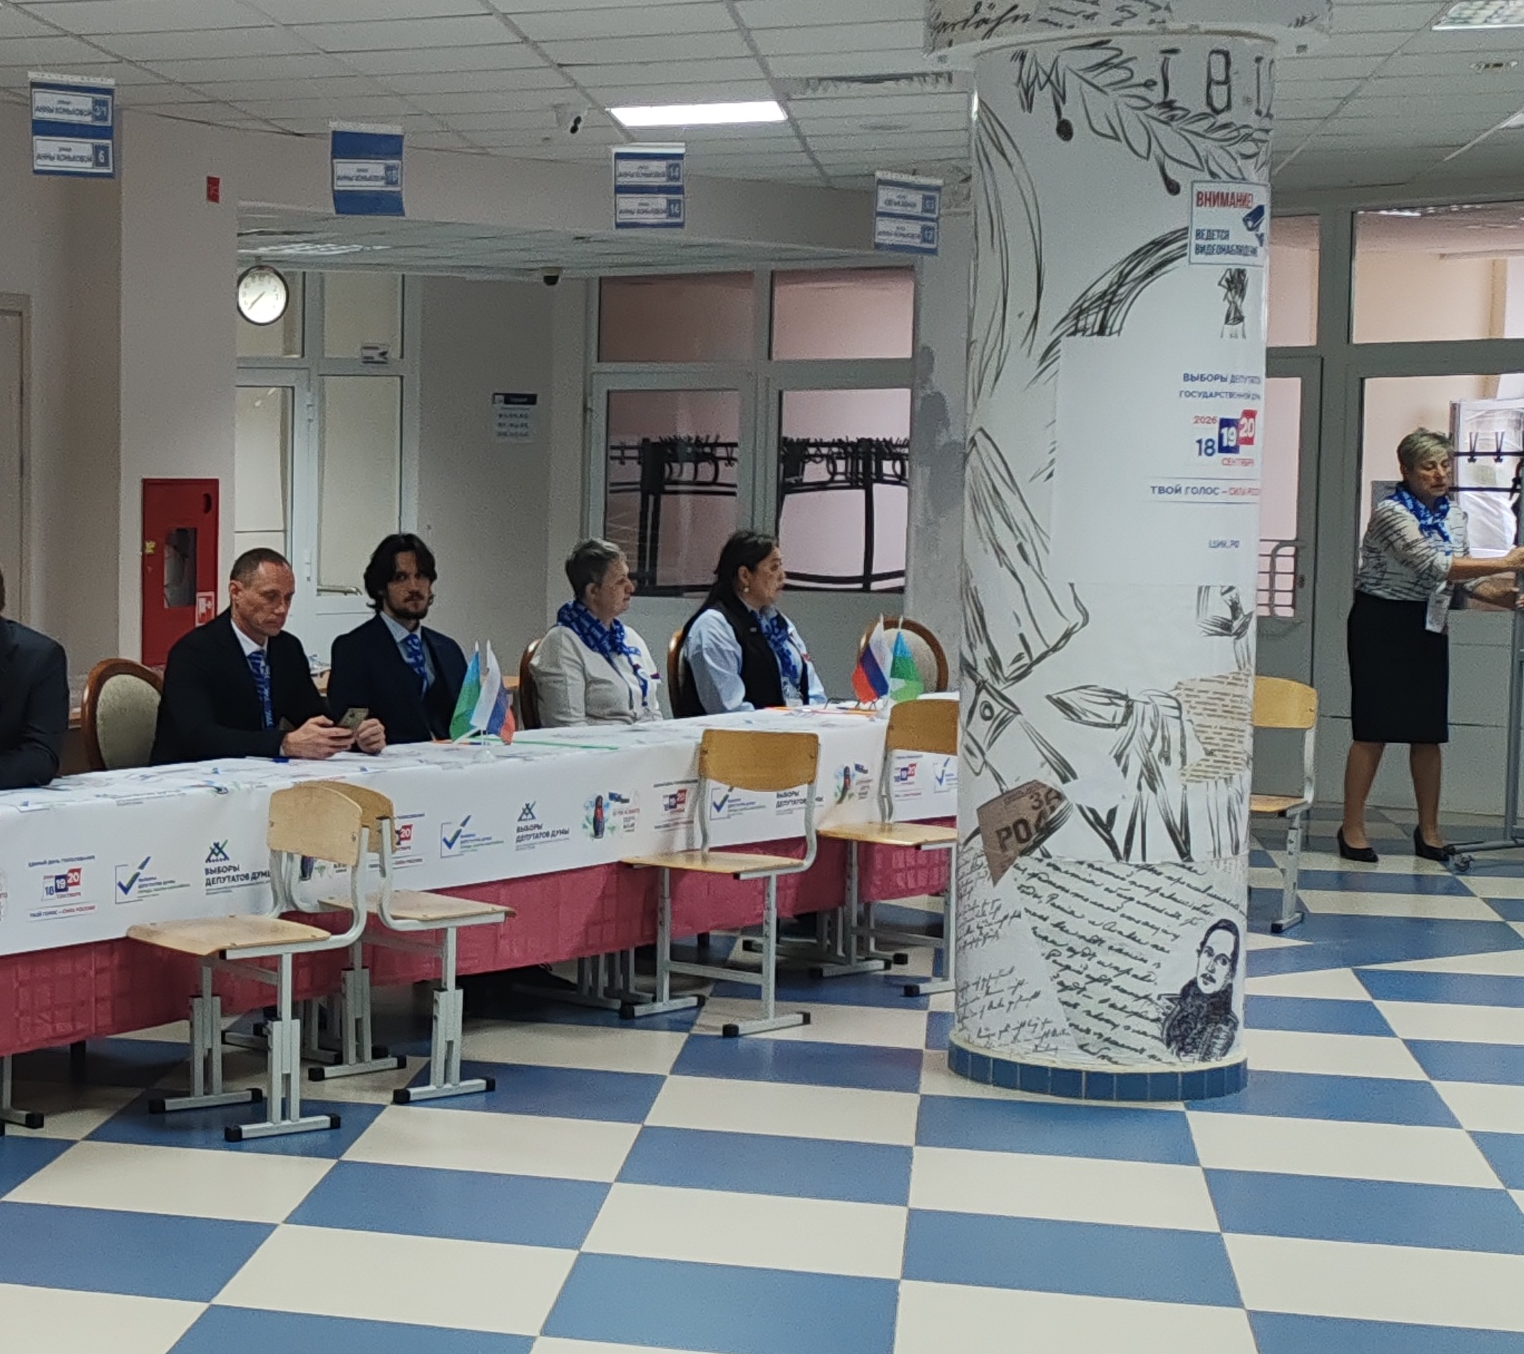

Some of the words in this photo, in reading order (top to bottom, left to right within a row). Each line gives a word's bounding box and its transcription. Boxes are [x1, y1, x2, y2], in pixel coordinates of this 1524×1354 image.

[98, 150, 106, 163] 6
[1196, 190, 1253, 209] ВНИМАНИЕ
[1182, 372, 1228, 383] ВЫБОРЫ
[1193, 415, 1218, 425] 2026
[1239, 416, 1255, 438] 20
[1220, 426, 1237, 447] 19
[1195, 438, 1217, 457] 18
[1150, 484, 1182, 495] ТВОЙ
[1184, 486, 1220, 496] ГОЛОС
[400, 828, 412, 838] 20
[516, 823, 543, 834] ВЫБОРЫ
[515, 830, 550, 844] ДЕПУТАТОВ
[205, 864, 240, 876] ВЫБОРЫ
[67, 871, 79, 884] 20
[205, 874, 250, 887] ДЕПУТАТОВ
[56, 878, 66, 890] 19
[45, 886, 54, 896] 18
